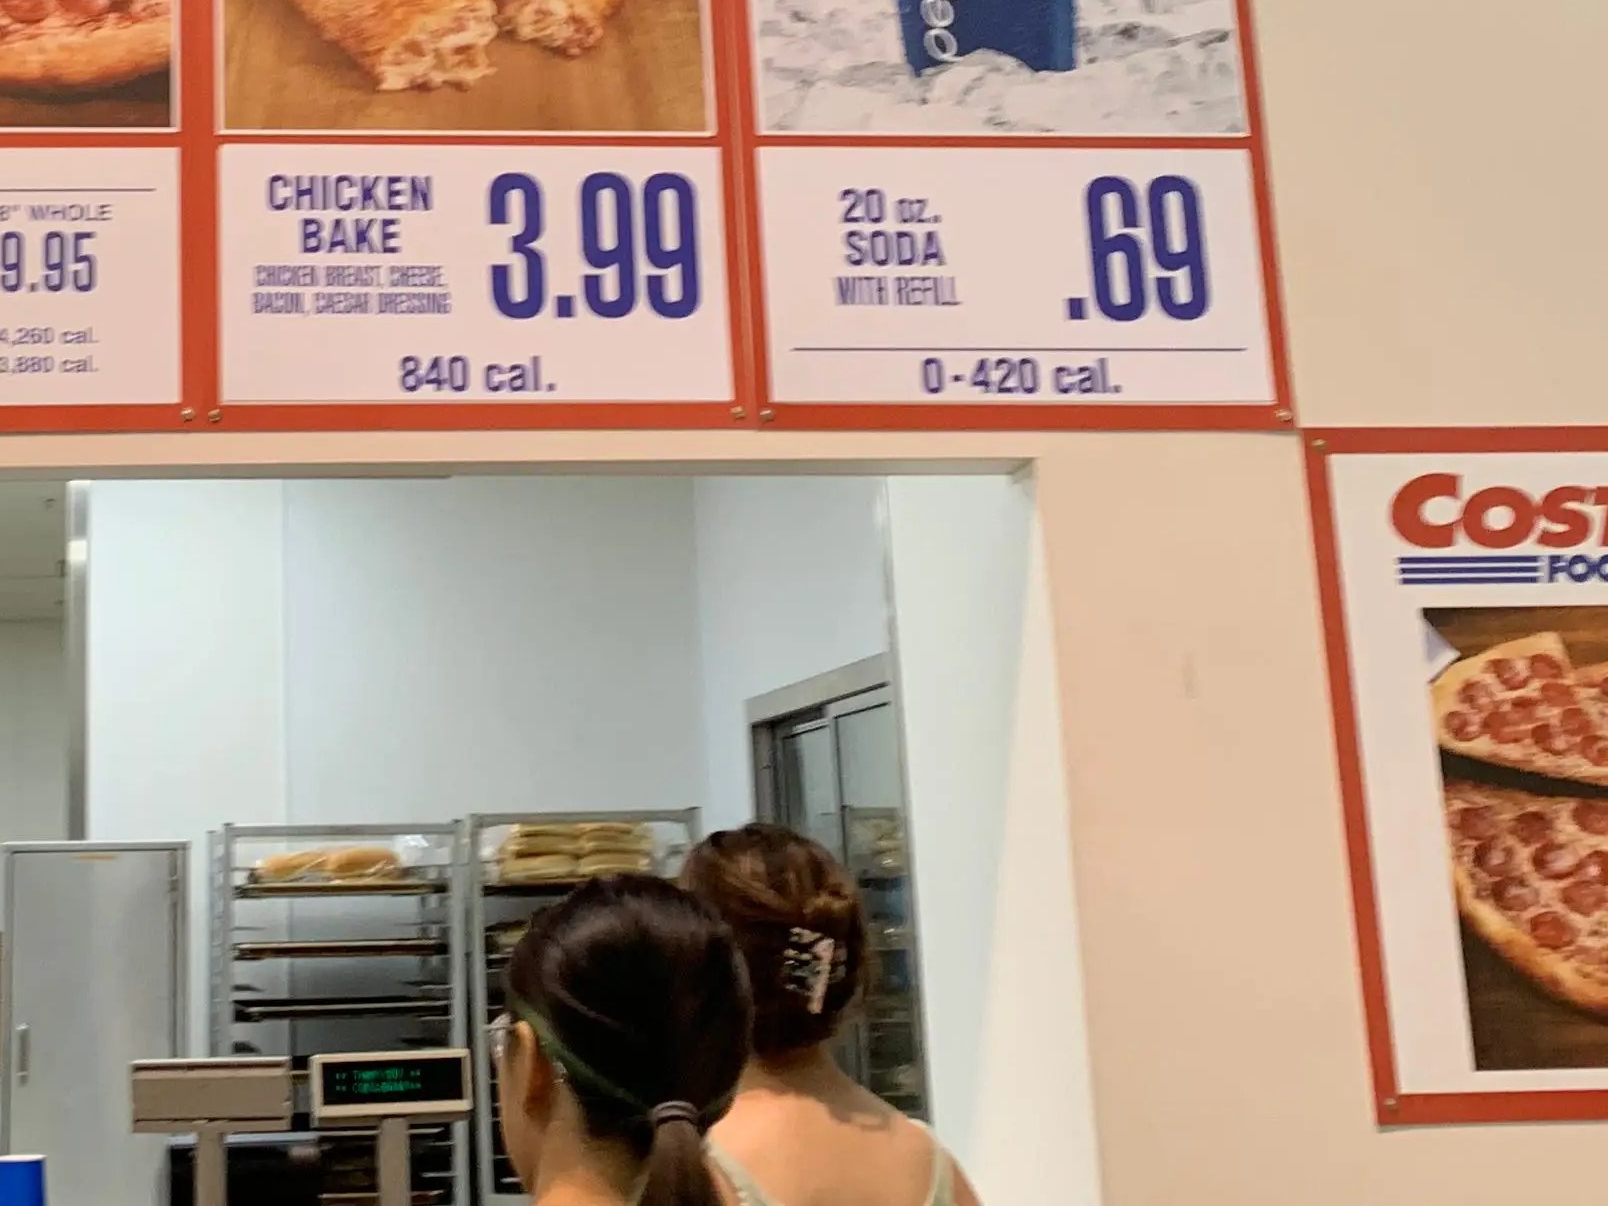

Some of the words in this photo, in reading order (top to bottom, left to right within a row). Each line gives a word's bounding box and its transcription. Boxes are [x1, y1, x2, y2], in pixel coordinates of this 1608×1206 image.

[269, 175, 431, 211] CHICKEN
[840, 189, 885, 224] 20
[896, 198, 941, 224] oz.
[29, 204, 112, 221] WHOLE
[302, 218, 400, 253] BAKE
[489, 172, 701, 319] 3.99
[846, 230, 944, 266] SODA
[1067, 175, 1210, 322] .69
[0, 231, 96, 292] 9.95
[836, 276, 888, 305] WITH
[894, 276, 961, 306] REFILL
[400, 356, 468, 392] 840
[484, 356, 555, 392] cal.
[1054, 358, 1121, 394] cal.
